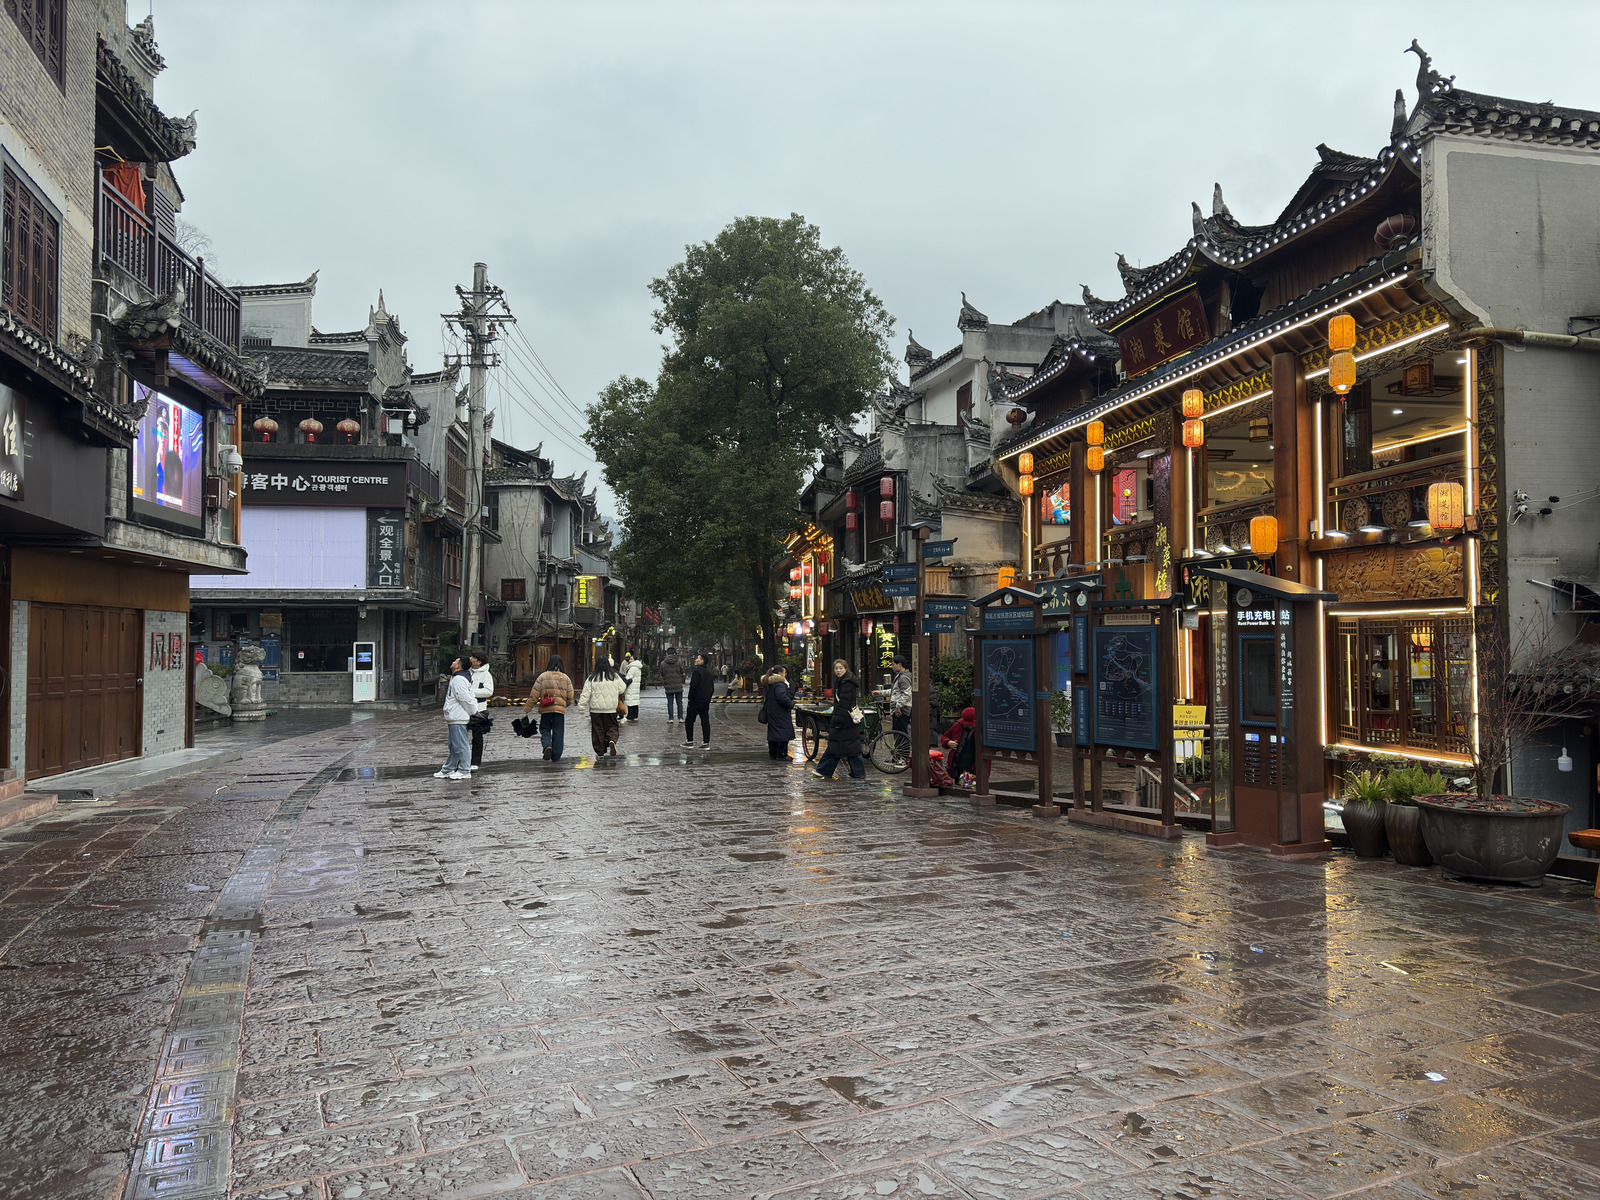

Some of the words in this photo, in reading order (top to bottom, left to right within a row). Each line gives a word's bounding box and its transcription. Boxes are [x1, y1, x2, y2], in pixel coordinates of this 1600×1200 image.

[1129, 307, 1195, 364] 湘菜馆
[311, 474, 350, 484] TOURIST
[351, 475, 389, 485] CENTRE
[379, 525, 394, 586] 观全景入口
[1156, 522, 1171, 592] 湘菜馆
